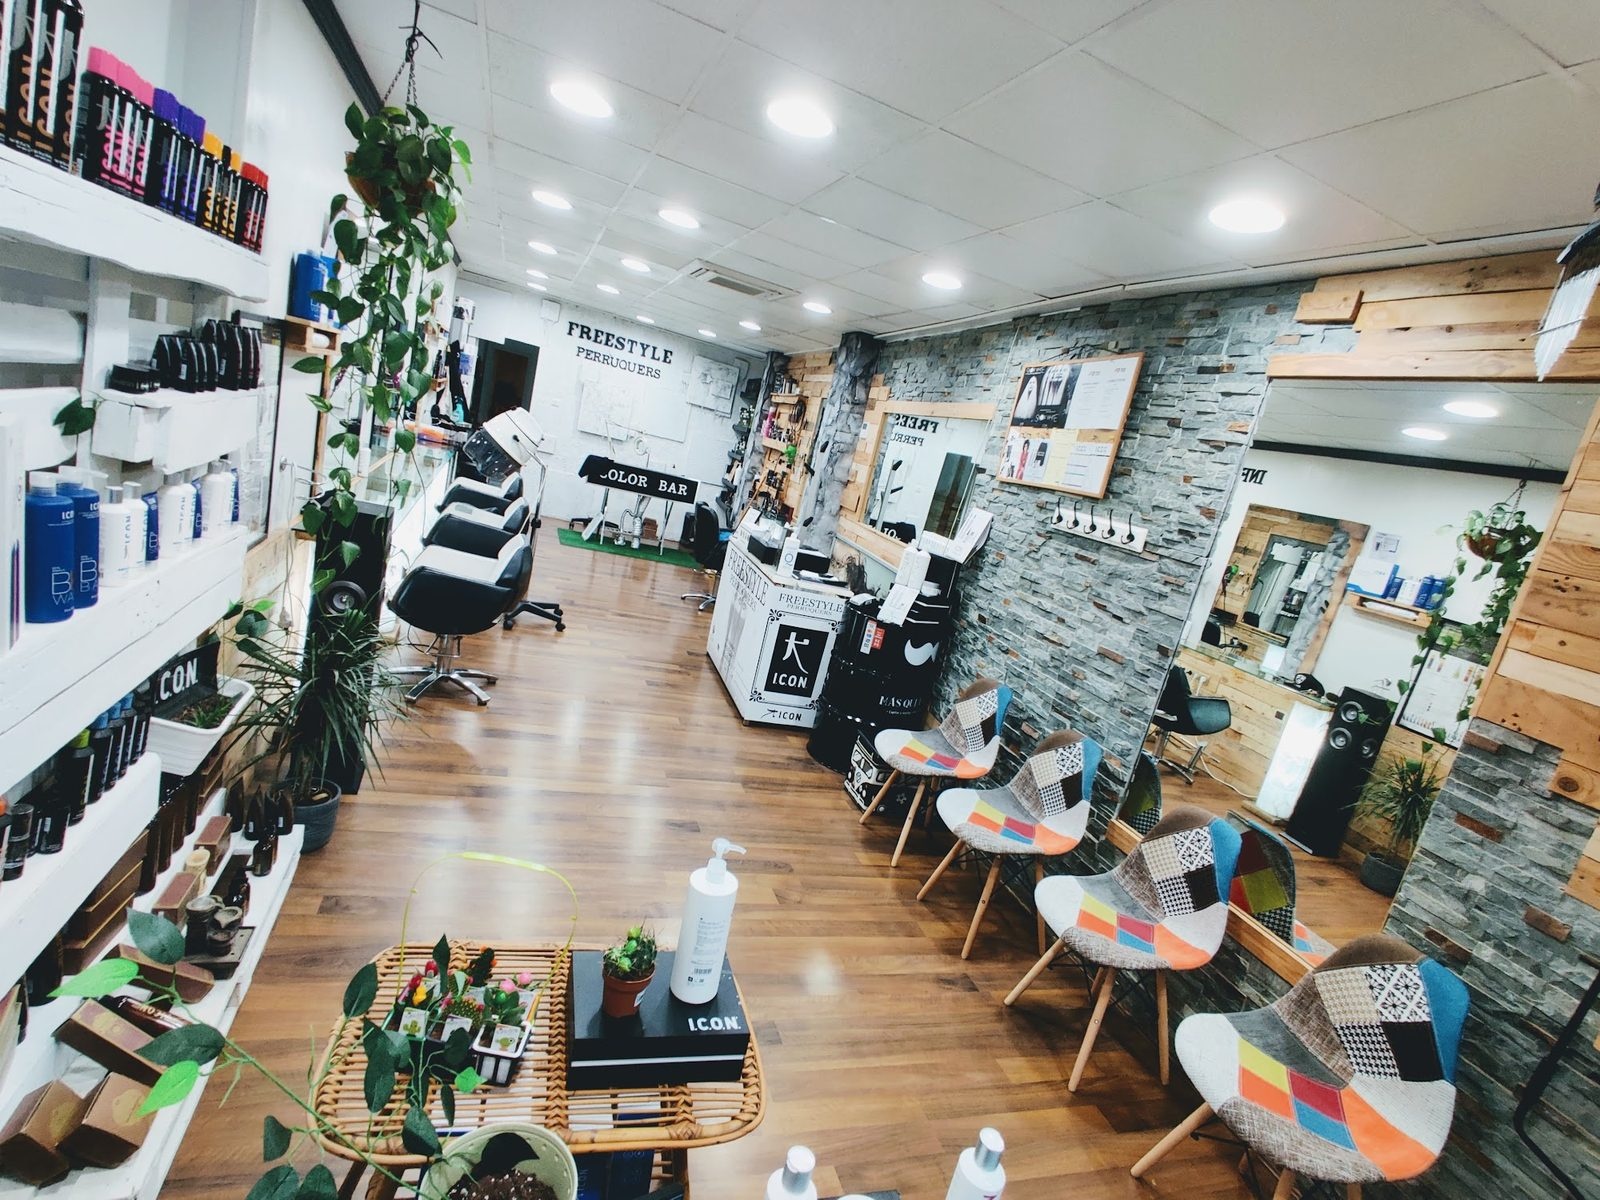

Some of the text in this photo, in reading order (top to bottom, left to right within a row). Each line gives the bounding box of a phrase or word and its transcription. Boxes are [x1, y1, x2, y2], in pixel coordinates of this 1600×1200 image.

[567, 321, 674, 364] FREESTYLE
[576, 346, 662, 379] PERRUQUERS
[658, 479, 688, 496] BAR
[779, 592, 844, 613] FREESTYLE
